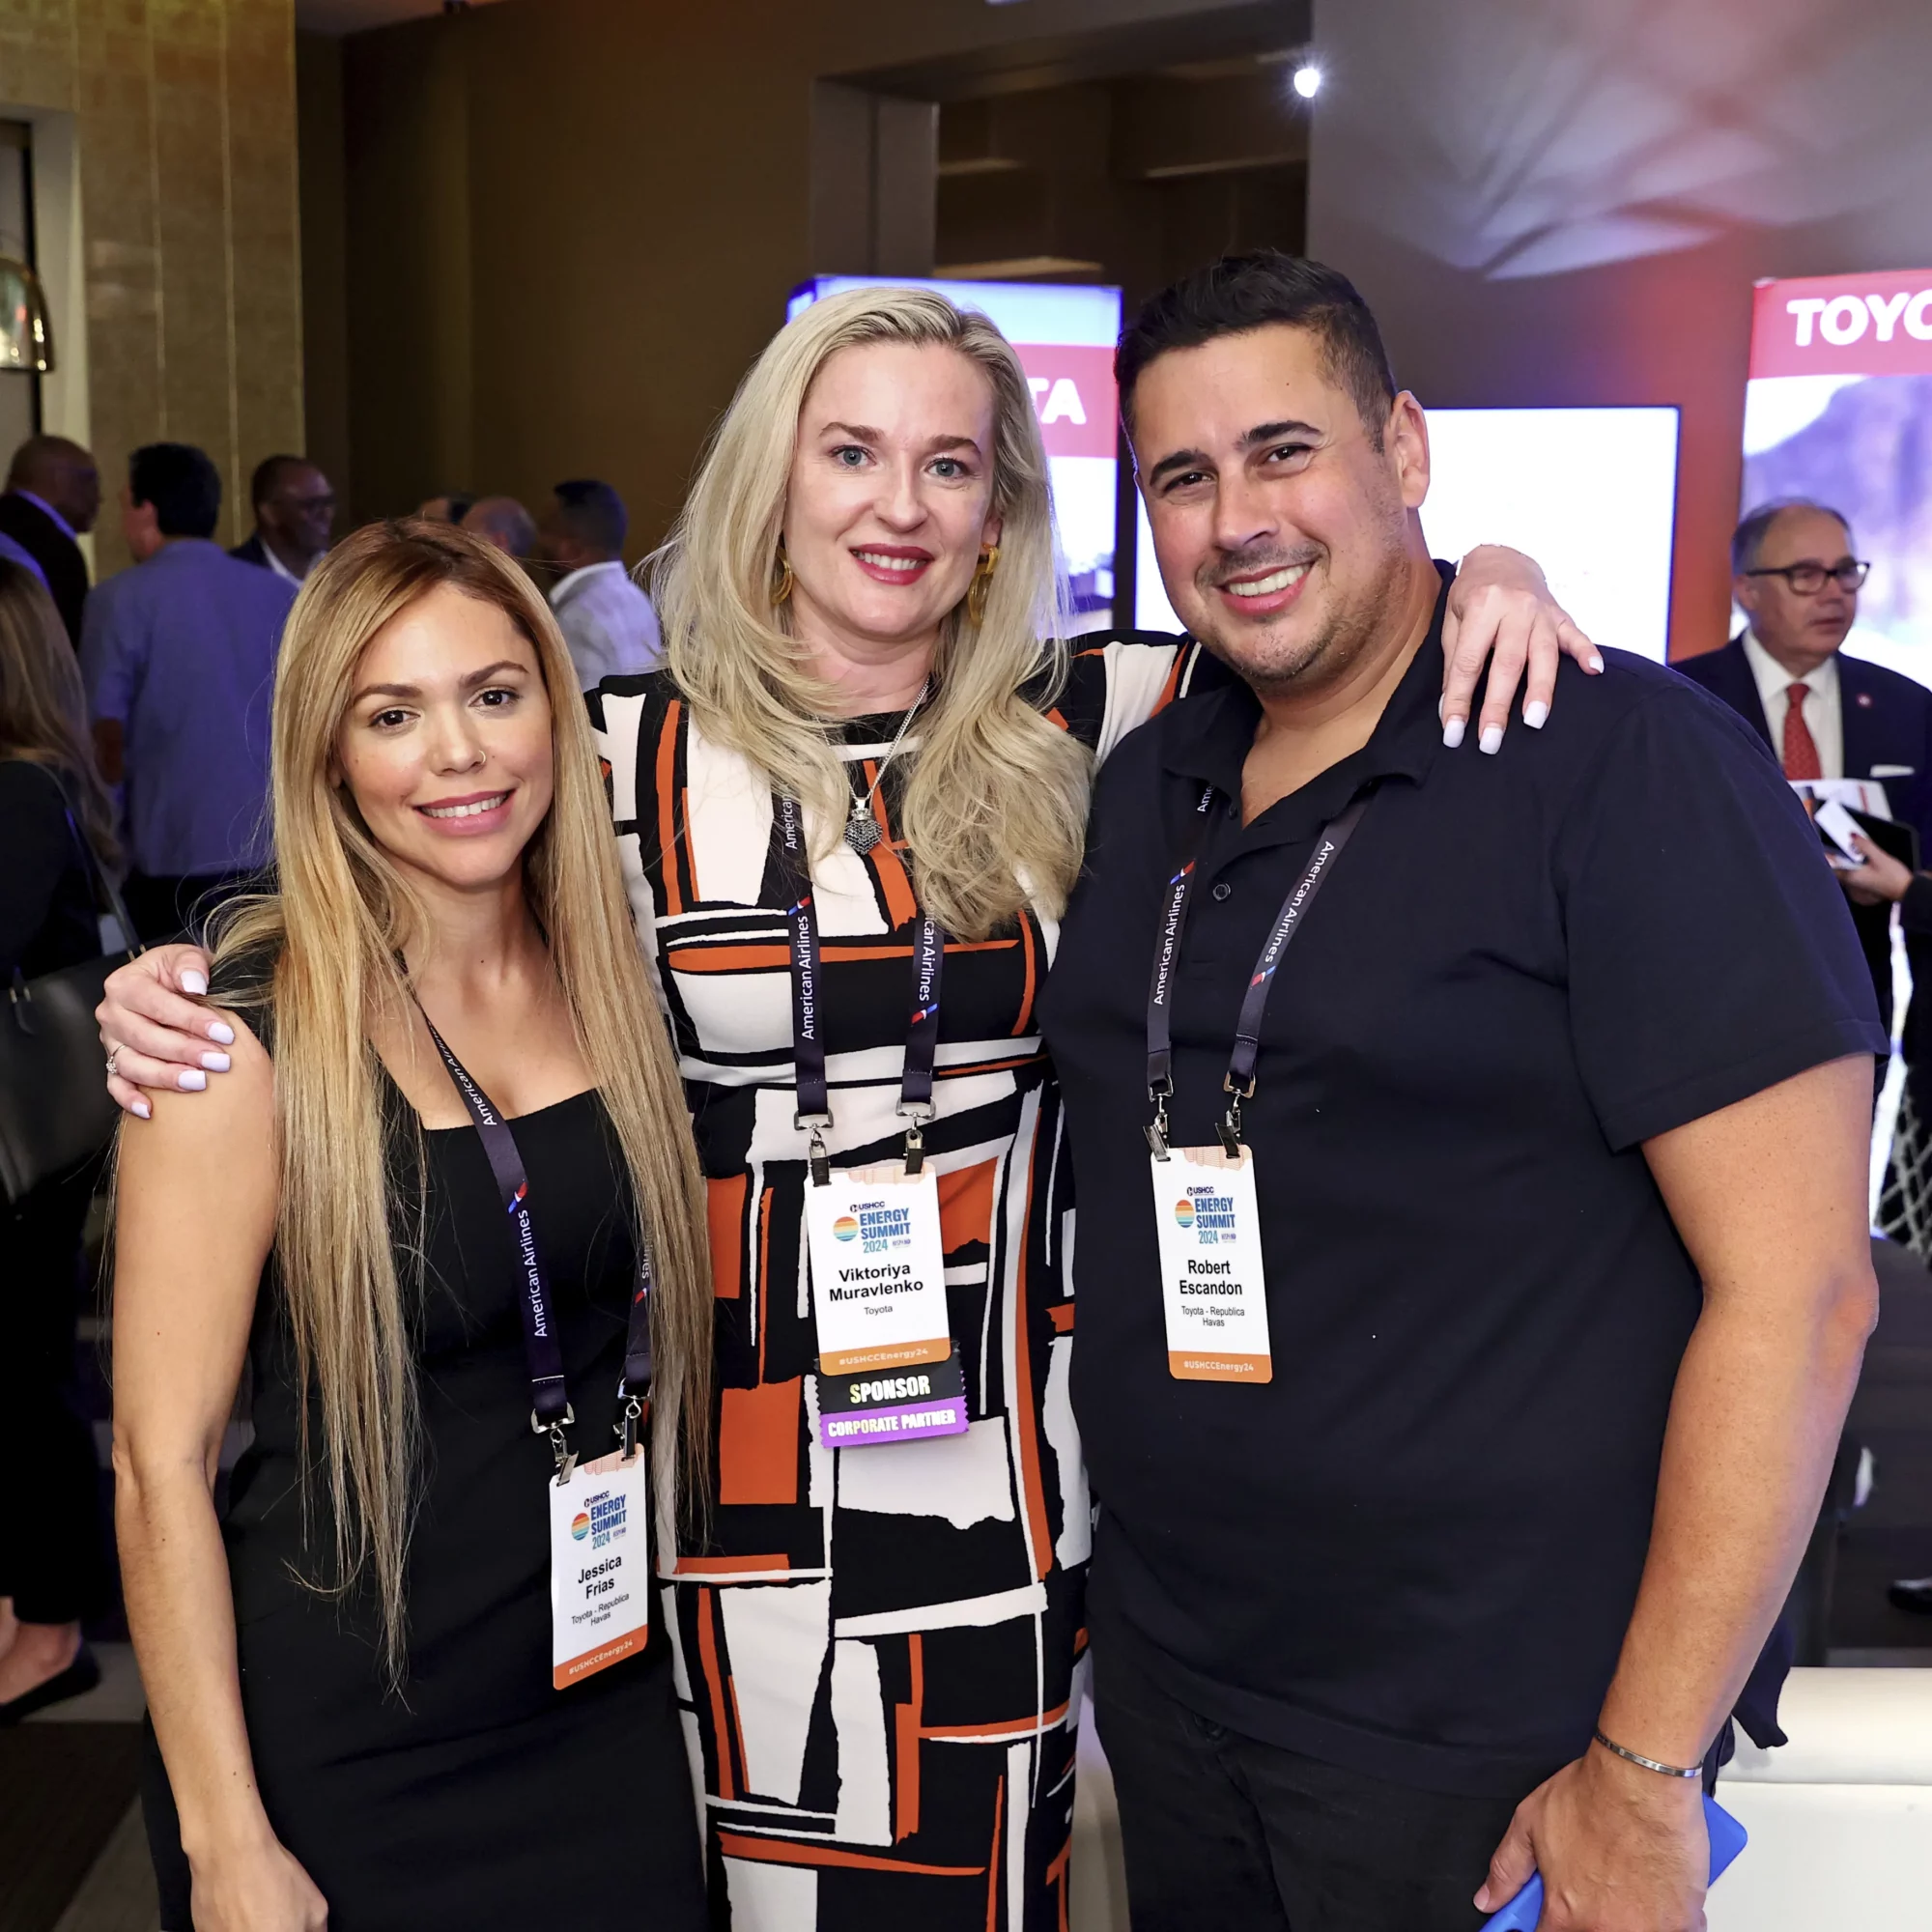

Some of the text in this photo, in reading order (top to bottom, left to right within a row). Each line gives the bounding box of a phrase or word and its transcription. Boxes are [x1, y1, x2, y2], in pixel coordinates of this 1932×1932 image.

[1264, 840, 1335, 964] American Airlines
[1153, 883, 1185, 1006] American Airlines
[797, 914, 815, 1040] American Airlines
[919, 946, 936, 1002] Airlines
[454, 1067, 497, 1125] American
[858, 1201, 885, 1210] USHCC
[1194, 1197, 1234, 1212] ENERGY
[860, 1208, 909, 1226] ENERGY
[1196, 1214, 1236, 1229] SUMMIT
[860, 1222, 911, 1239] SUMMIT
[1198, 1230, 1219, 1244] 2024
[863, 1238, 888, 1254] 2024
[518, 1209, 548, 1337] American Airlines
[838, 1264, 911, 1283] Viktoriya
[1188, 1259, 1232, 1275] Robert
[829, 1280, 923, 1302] Muravlenko
[1179, 1280, 1242, 1295] Escandon
[864, 1304, 894, 1316] Toyota
[1181, 1305, 1205, 1317] Toyota
[1209, 1305, 1245, 1318] Republica
[1203, 1317, 1225, 1327] Havas
[838, 1348, 928, 1366] #USHCCEnergy24
[1183, 1359, 1254, 1372] #USHCCEnergy24
[850, 1376, 931, 1404] SPONSOR
[828, 1408, 956, 1437] CORPORATE PARTNER
[591, 1493, 626, 1520] ENERGY
[591, 1509, 627, 1535] SUMMIT
[592, 1531, 611, 1550] 2024
[578, 1555, 622, 1584] Jessica
[585, 1577, 615, 1600] Frias
[572, 1610, 593, 1625] Toyota
[590, 1611, 611, 1626] Havas
